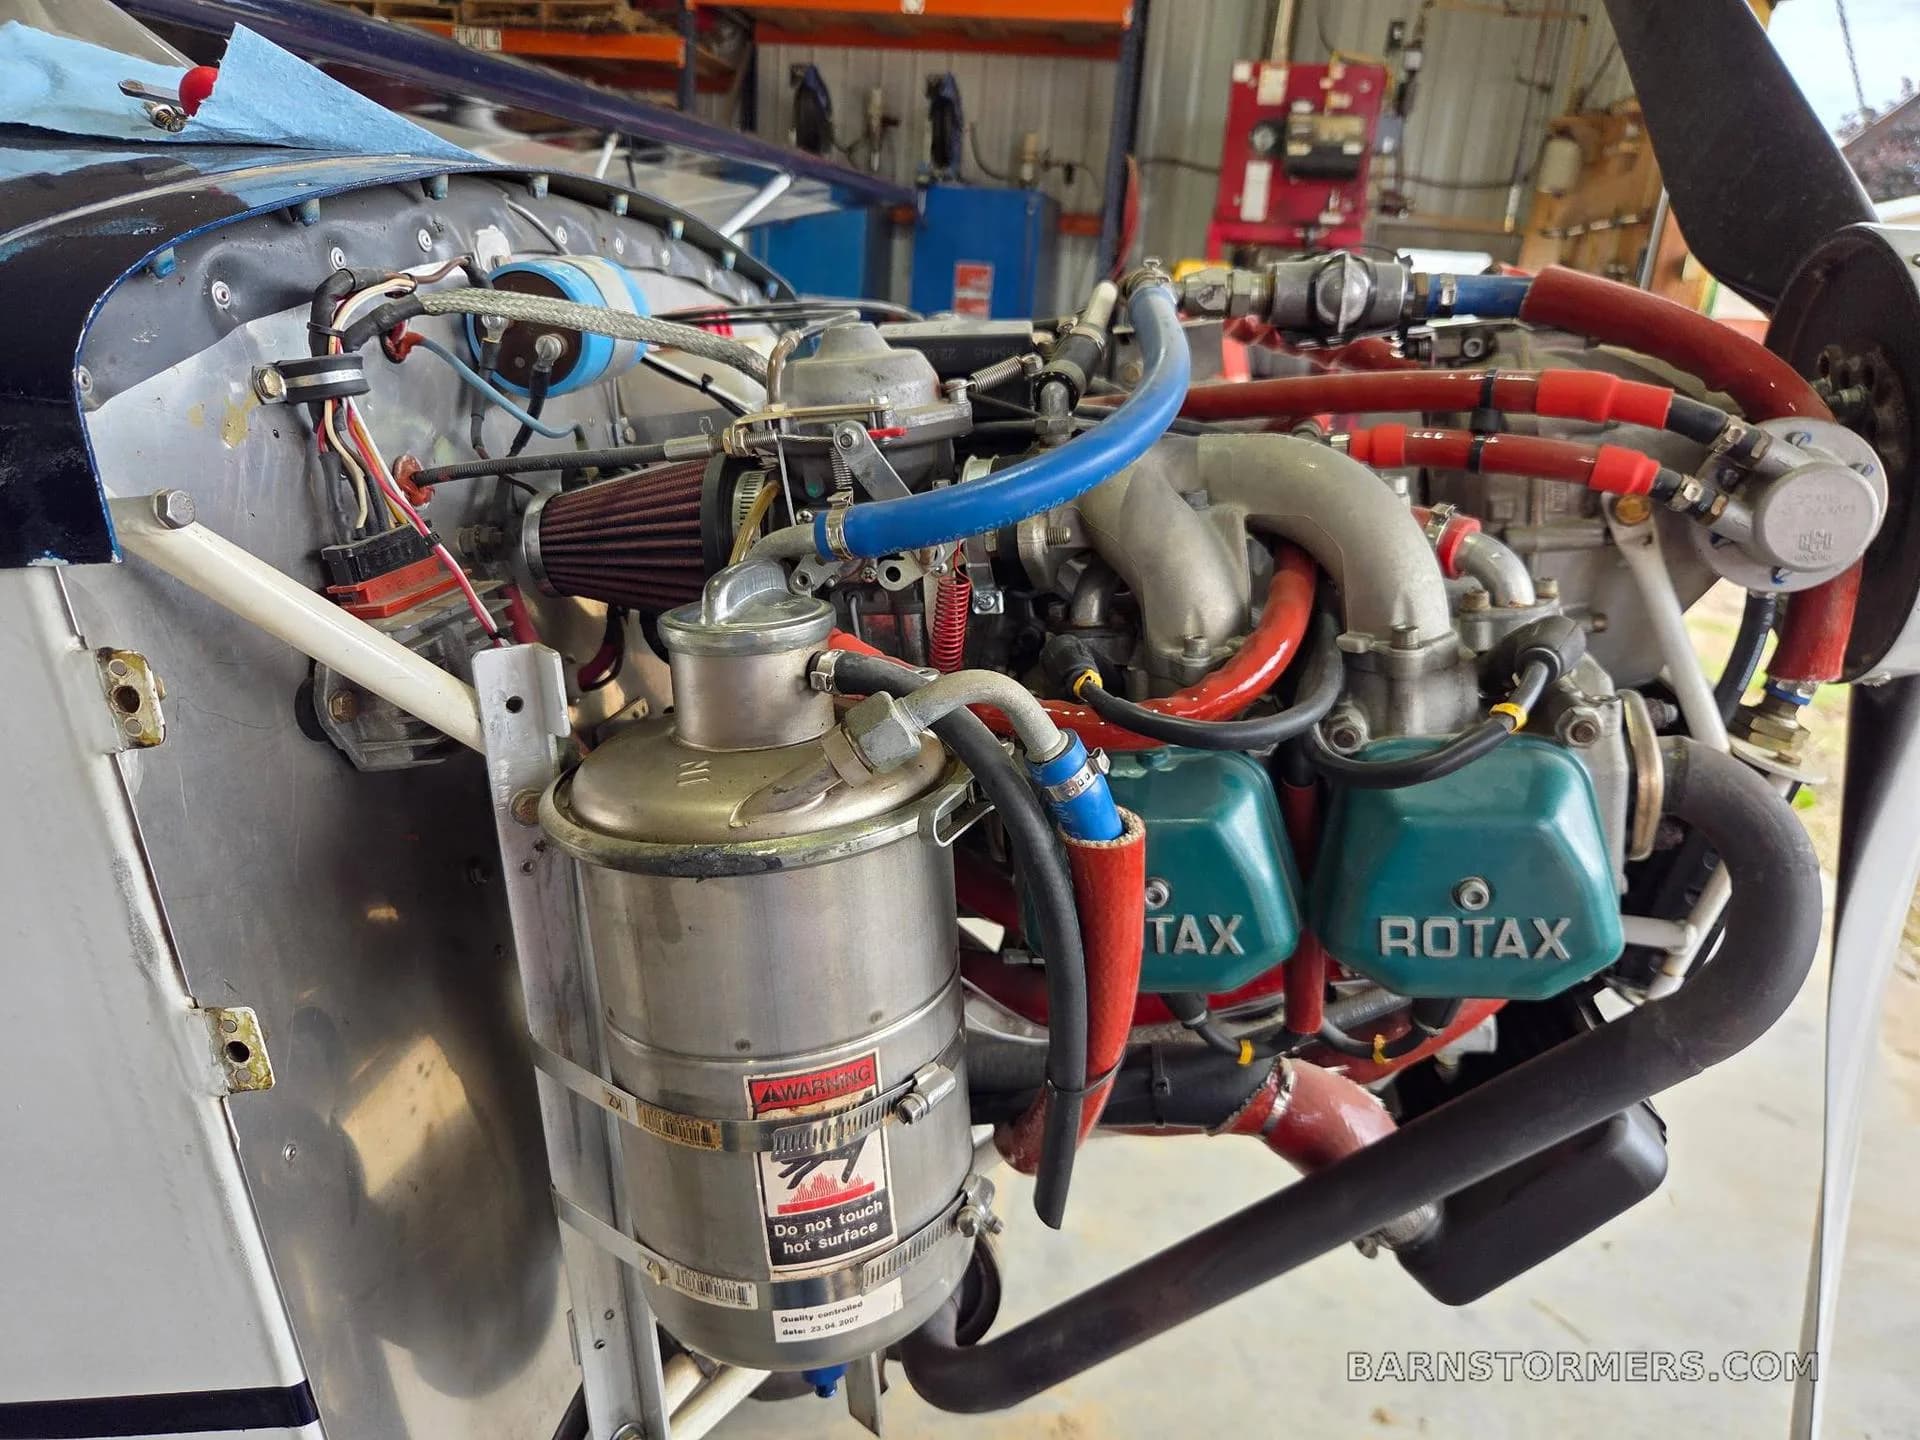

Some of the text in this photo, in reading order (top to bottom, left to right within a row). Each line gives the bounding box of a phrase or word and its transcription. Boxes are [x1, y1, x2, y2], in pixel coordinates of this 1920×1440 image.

[1144, 914, 1246, 955] TAX
[1380, 915, 1572, 960] ROTAX
[781, 1064, 872, 1100] WARNING
[774, 1199, 884, 1237] Do not touch
[783, 1221, 879, 1255] hot surface
[780, 1300, 864, 1325] Quality controlled
[782, 1327, 807, 1337] date:
